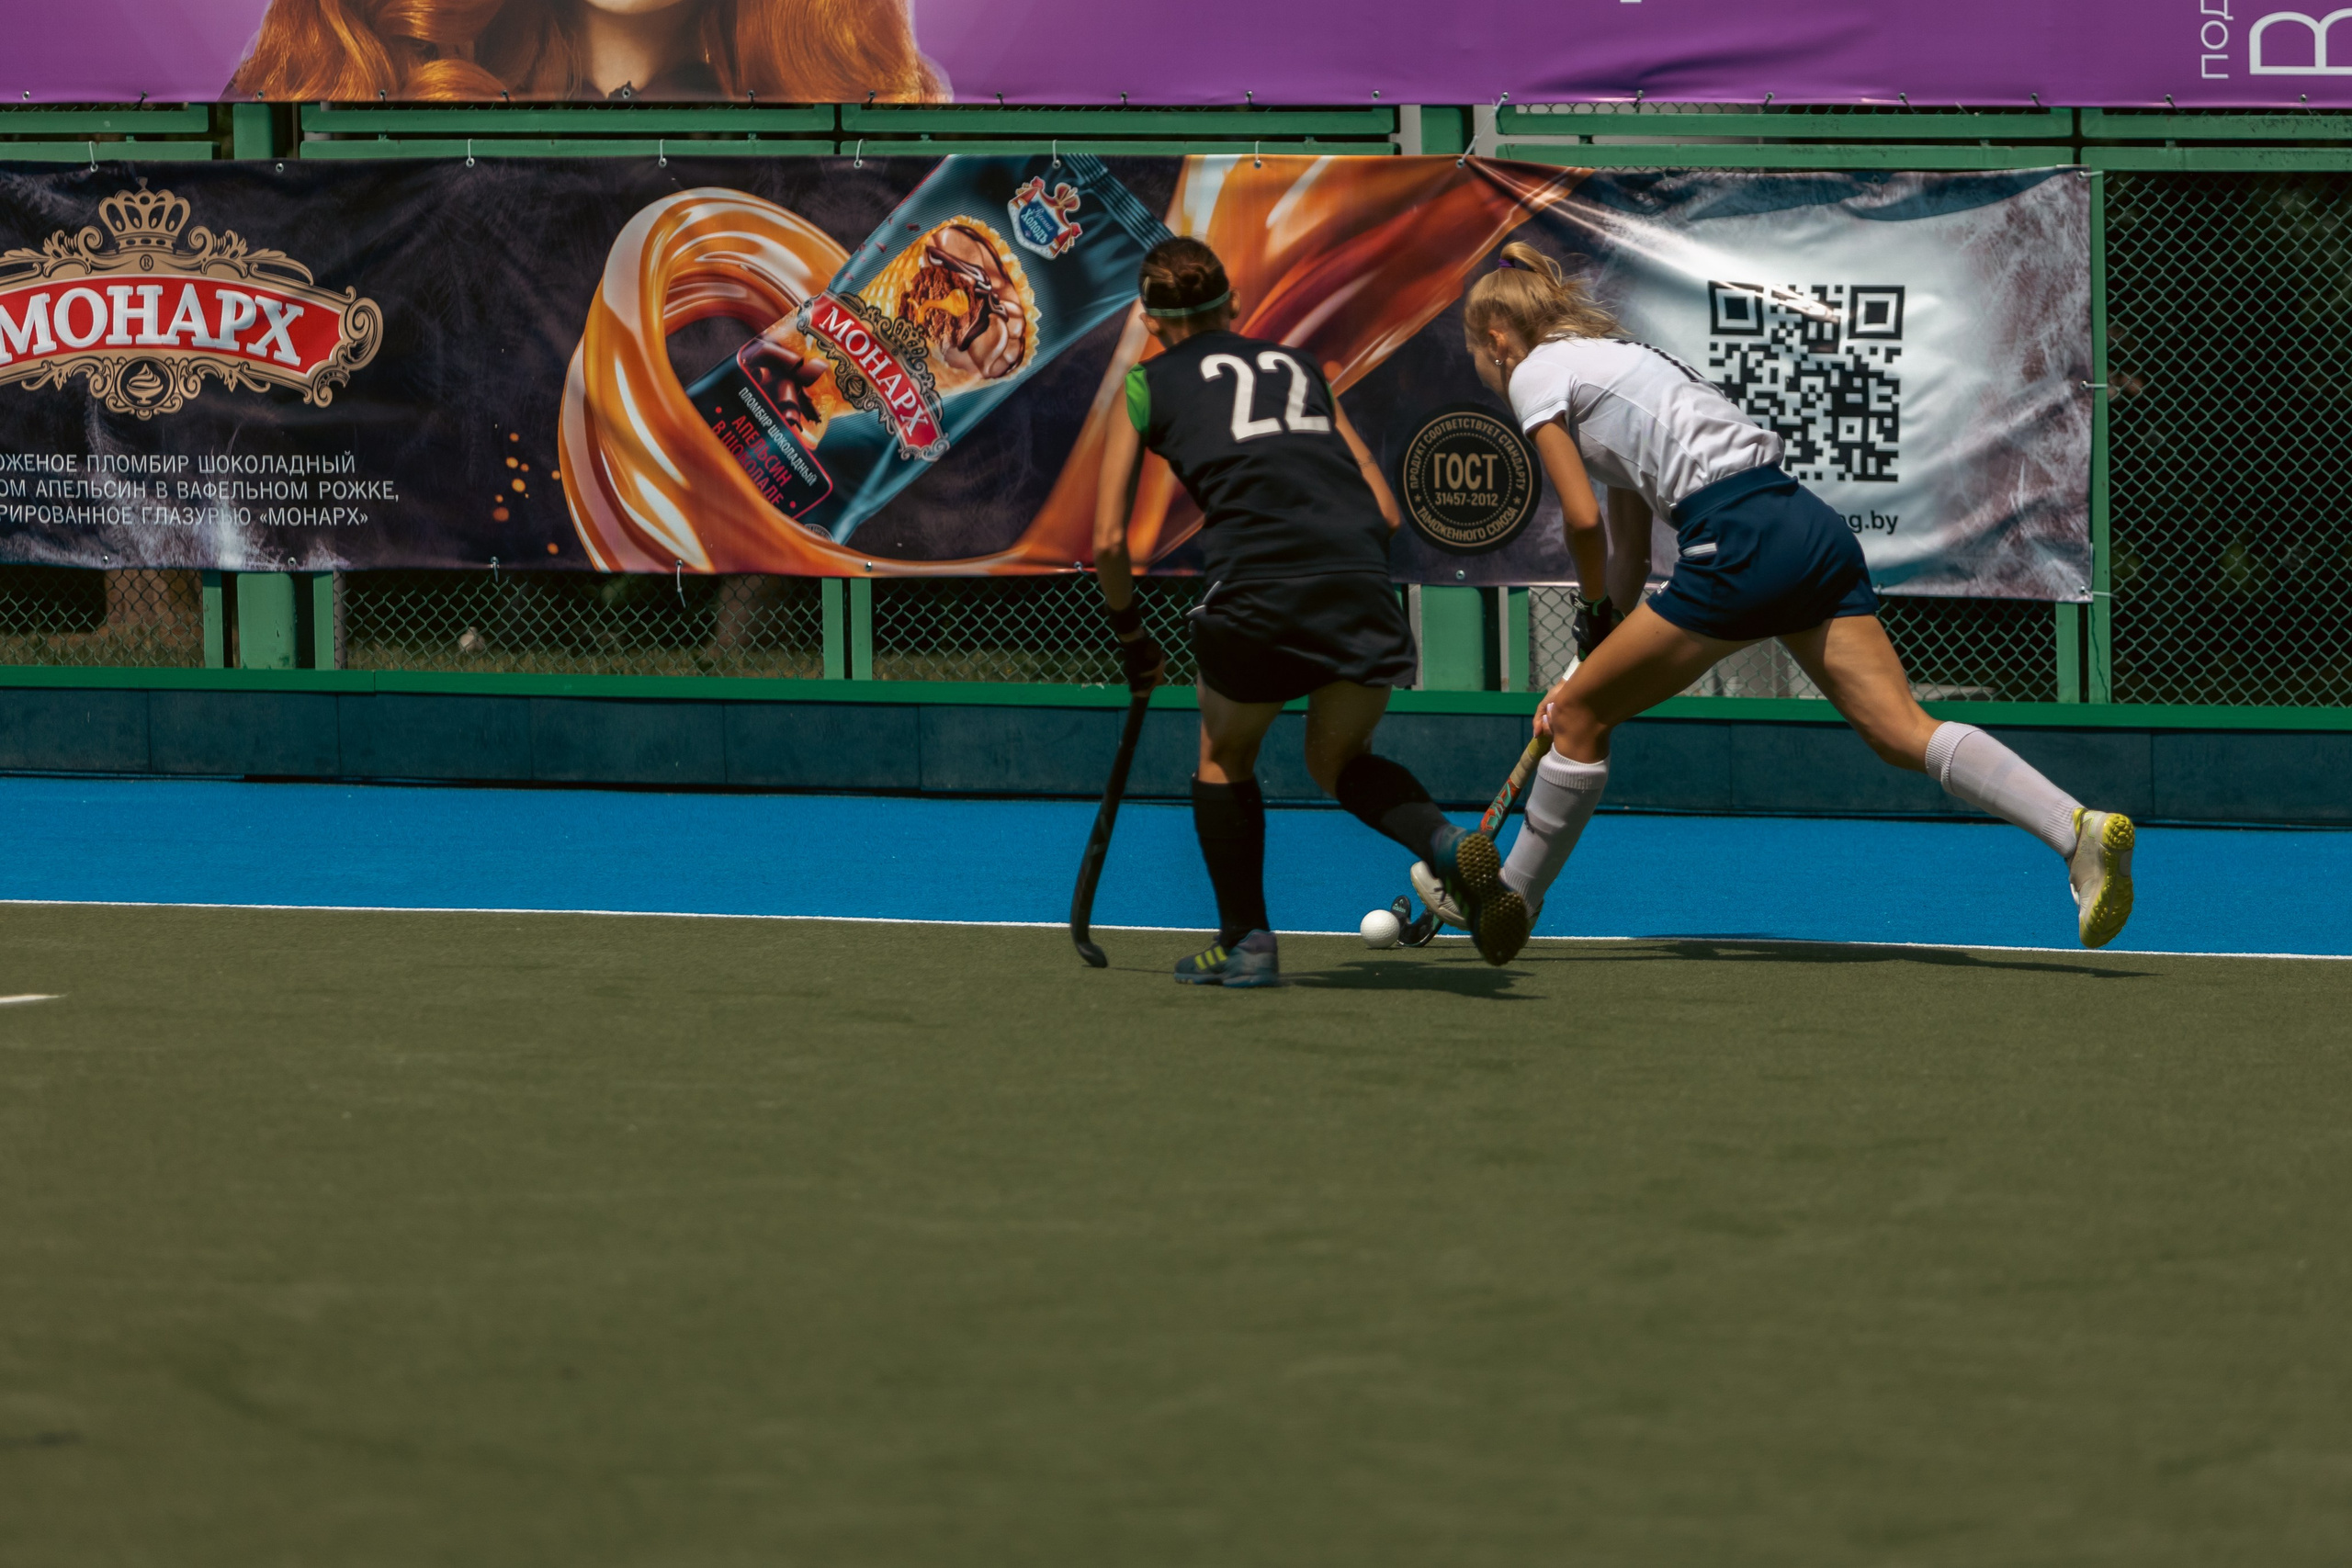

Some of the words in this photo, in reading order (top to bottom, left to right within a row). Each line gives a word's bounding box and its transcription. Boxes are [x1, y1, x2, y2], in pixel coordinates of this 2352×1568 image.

[0, 284, 304, 367] МОНАРХ
[819, 306, 929, 436] МОНАРХ
[1199, 350, 1330, 443] 22
[731, 415, 793, 487] АПЕЛЬСИН
[739, 387, 773, 428] ПЛОМБИР
[767, 424, 818, 487] ШОКОЛАДНЫЙ
[1410, 442, 1428, 490] ПРОДУКТ
[1425, 418, 1501, 443] СООТВЕТСТВУЕТ
[1498, 434, 1526, 491] СТАНДАРТУ
[87, 455, 189, 473] ПЛОМБИР
[198, 450, 356, 476] ШОКОЛАДНЫЙ
[1433, 453, 1498, 491] ГОСТ
[36, 479, 146, 499] АПЕЛЬСИН
[156, 480, 168, 499] В
[177, 481, 308, 500] ВАФЕЛЬНОМ
[319, 481, 399, 502] РОЖКЕ,
[1435, 492, 1498, 505] 31457-2012
[141, 506, 251, 525] ГЛАЗУРЬЮ
[259, 507, 368, 526] «МОНАРХ»
[1417, 506, 1486, 541] ТАМОЖЕННОГО
[1486, 506, 1519, 535] СОЮЗА
[1838, 510, 1898, 535] g.by
